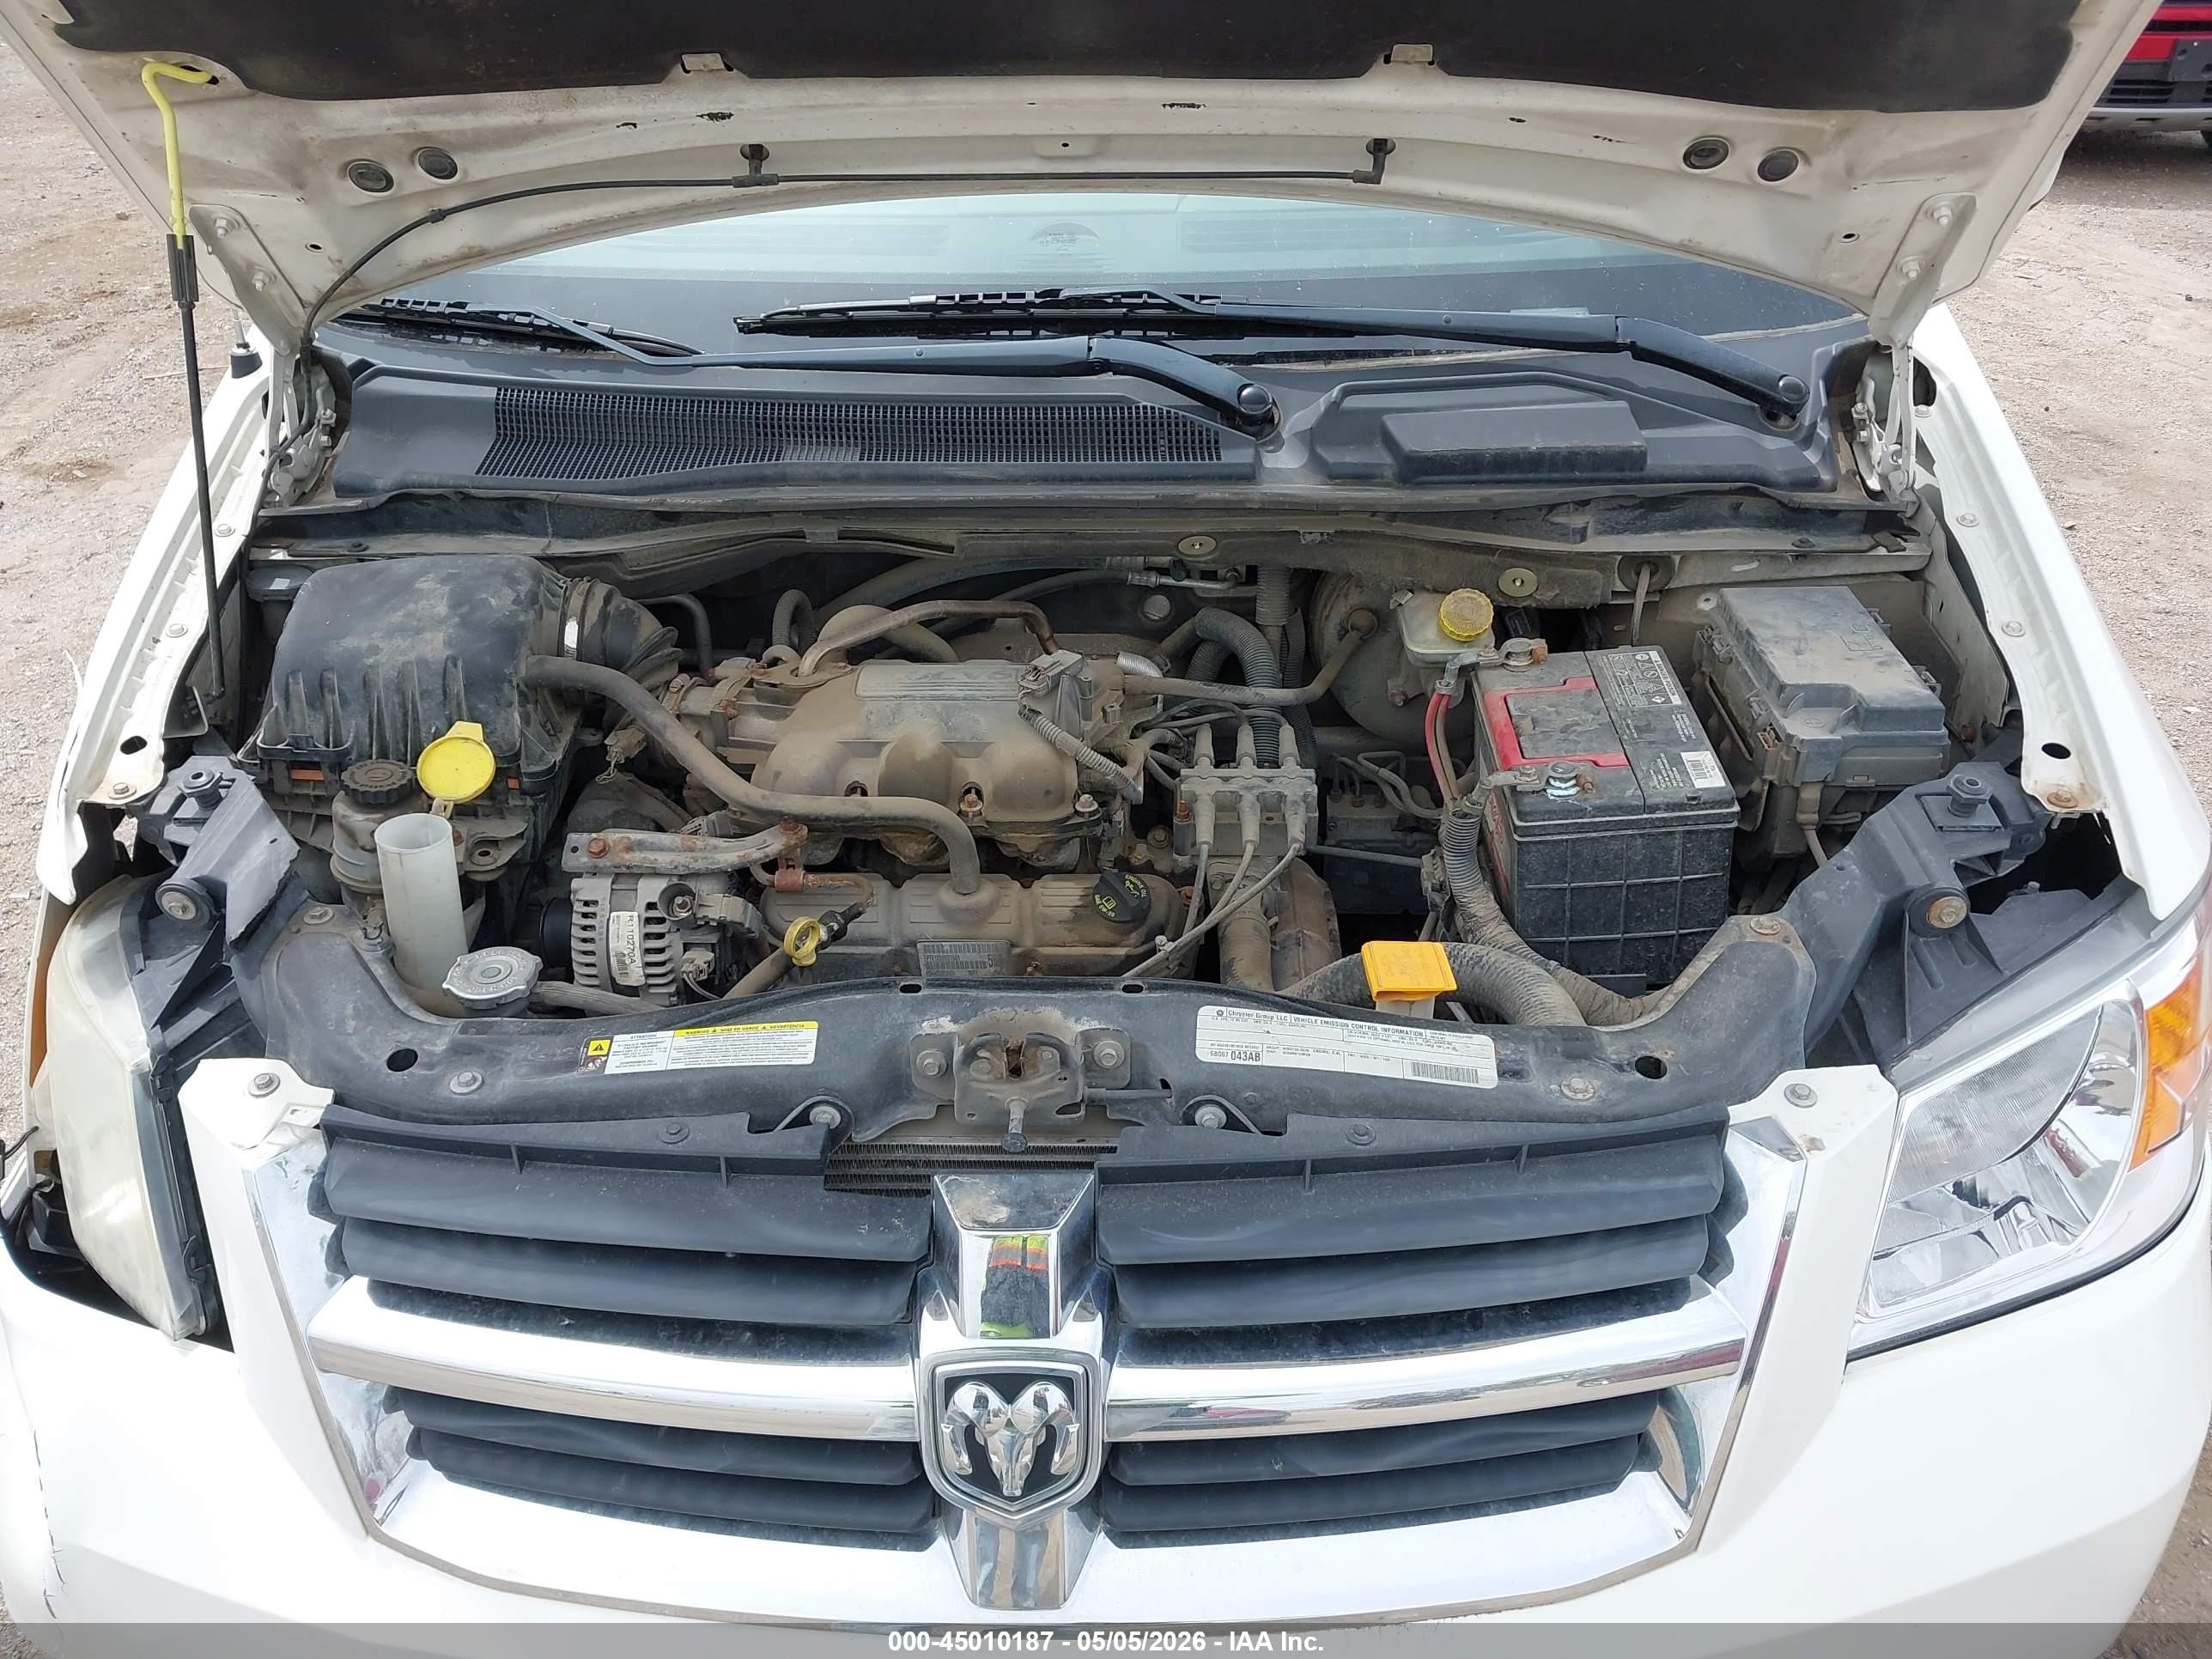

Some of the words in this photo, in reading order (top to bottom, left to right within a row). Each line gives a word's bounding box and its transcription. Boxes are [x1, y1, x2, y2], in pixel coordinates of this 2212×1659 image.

[1125, 874, 1144, 889] ENGINE
[1094, 894, 1103, 905] SAE
[626, 915, 637, 965] R110270A
[1228, 1010, 1254, 1018] Chrysler
[1320, 1019, 1349, 1029] EMISSION
[1351, 1023, 1378, 1031] CONTROL
[1381, 1026, 1424, 1037] INFORMATION
[1231, 1050, 1261, 1062] 043AB
